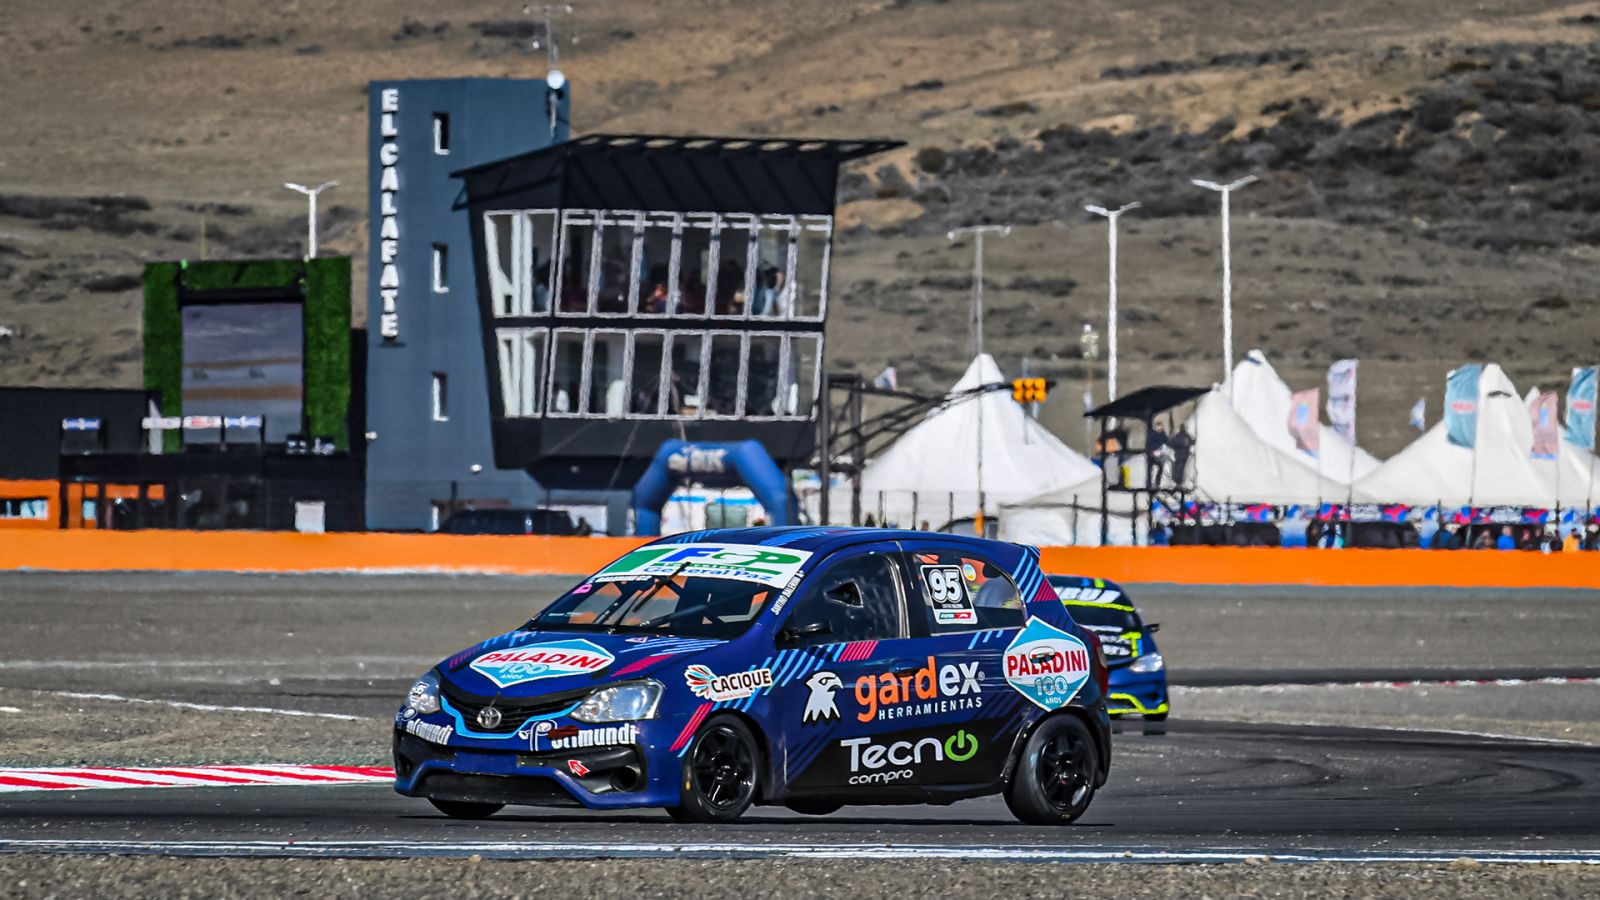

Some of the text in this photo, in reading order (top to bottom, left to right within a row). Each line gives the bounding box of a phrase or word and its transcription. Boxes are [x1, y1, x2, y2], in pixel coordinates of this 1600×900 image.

[380, 88, 400, 337] EL CALAFATE
[733, 569, 773, 581] Paz
[928, 568, 963, 605] 95
[477, 652, 608, 669] PALADINI
[498, 662, 550, 675] 100
[1007, 649, 1088, 677] PALADINI
[710, 670, 771, 693] CACIQUE
[855, 656, 982, 722] gardex
[1034, 676, 1068, 696] 100
[878, 696, 983, 720] HERRAMIENTAS
[849, 769, 914, 784] compro
